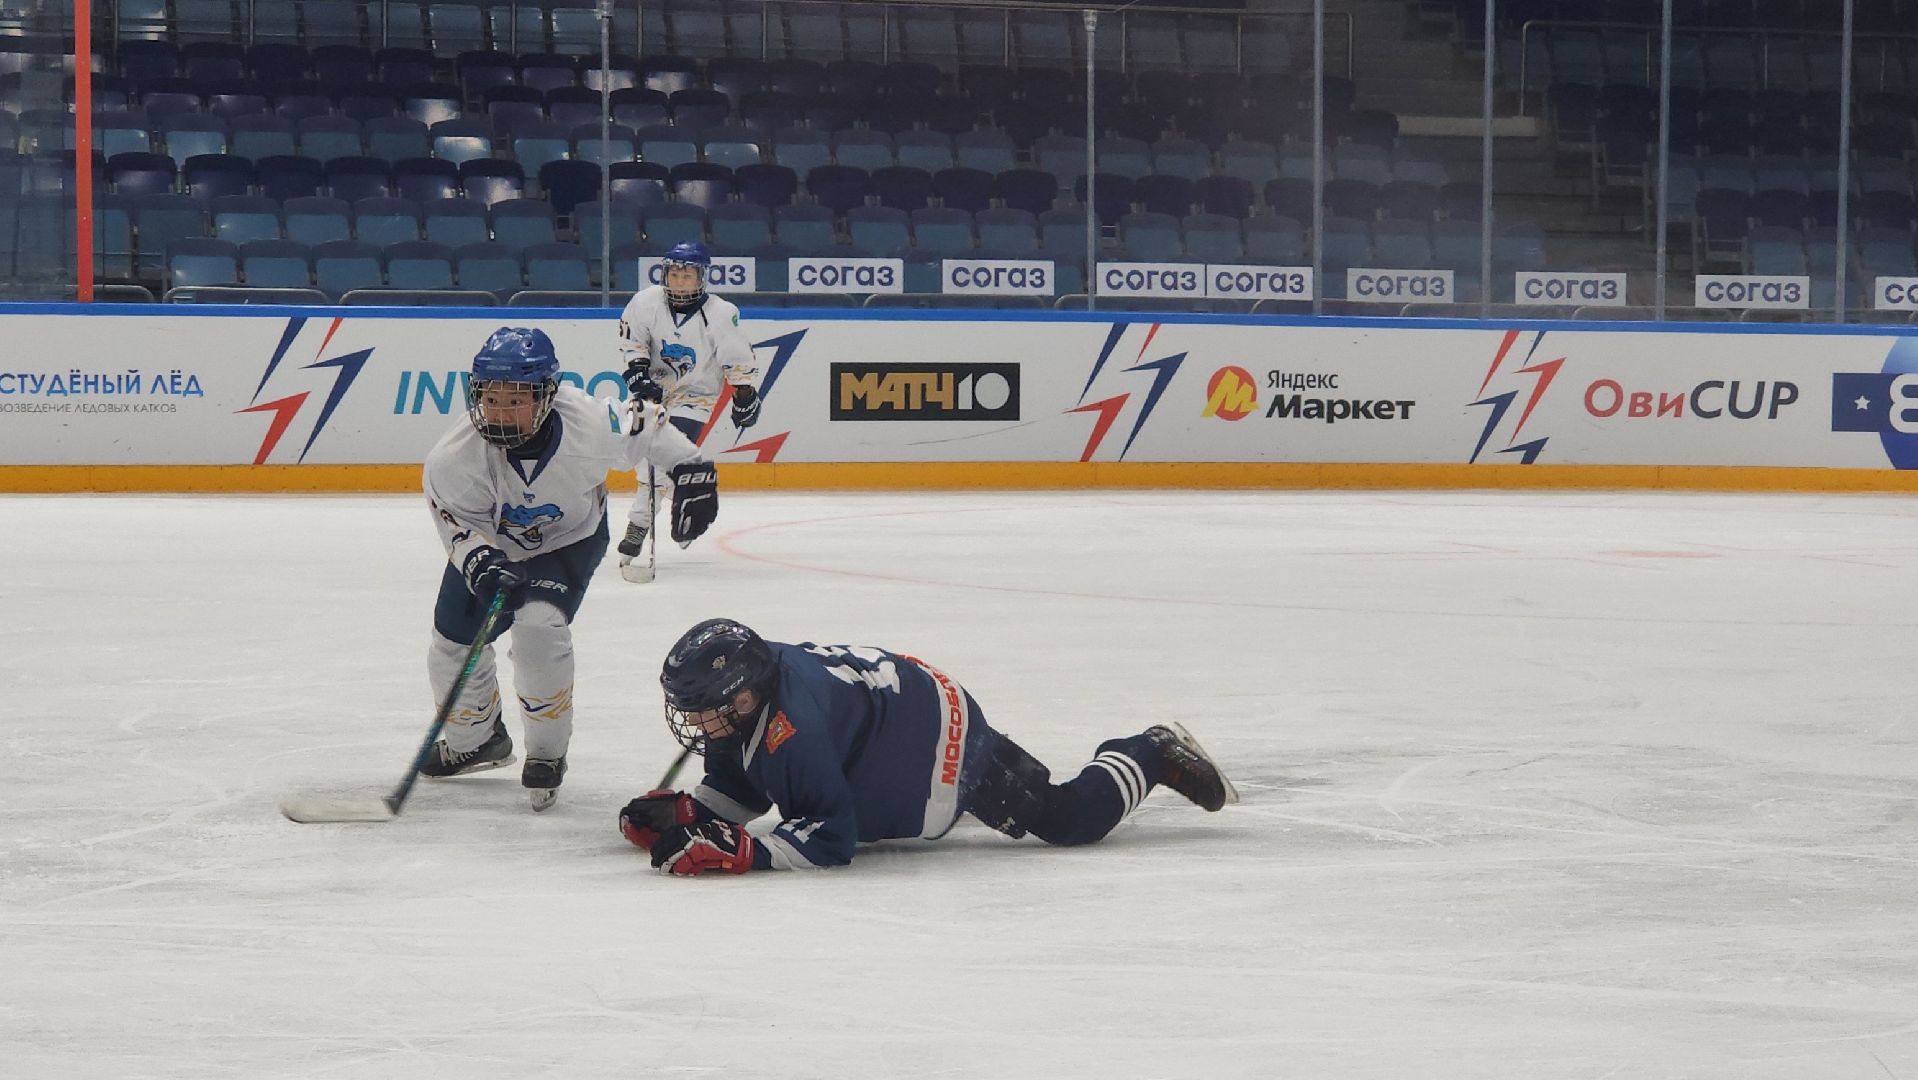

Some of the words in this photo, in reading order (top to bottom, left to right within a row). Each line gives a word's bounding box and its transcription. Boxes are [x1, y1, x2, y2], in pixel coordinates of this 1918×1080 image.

[648, 264, 746, 286] саз
[799, 264, 895, 287] согаз
[952, 266, 1046, 288] согаз
[1106, 269, 1197, 291] согаз
[1215, 271, 1305, 293] согаз
[1355, 274, 1446, 297] согаз
[1524, 278, 1618, 300] согаз
[1705, 281, 1801, 303] согаз
[0, 369, 141, 397] СТУДЁНЫЙ
[151, 369, 204, 397] ЛЁД
[1267, 370, 1338, 389] Яндекс
[75, 403, 129, 414] ЛЕДОВЫХ
[133, 403, 177, 413] КАТКОВ
[1266, 394, 1415, 423] Маркет
